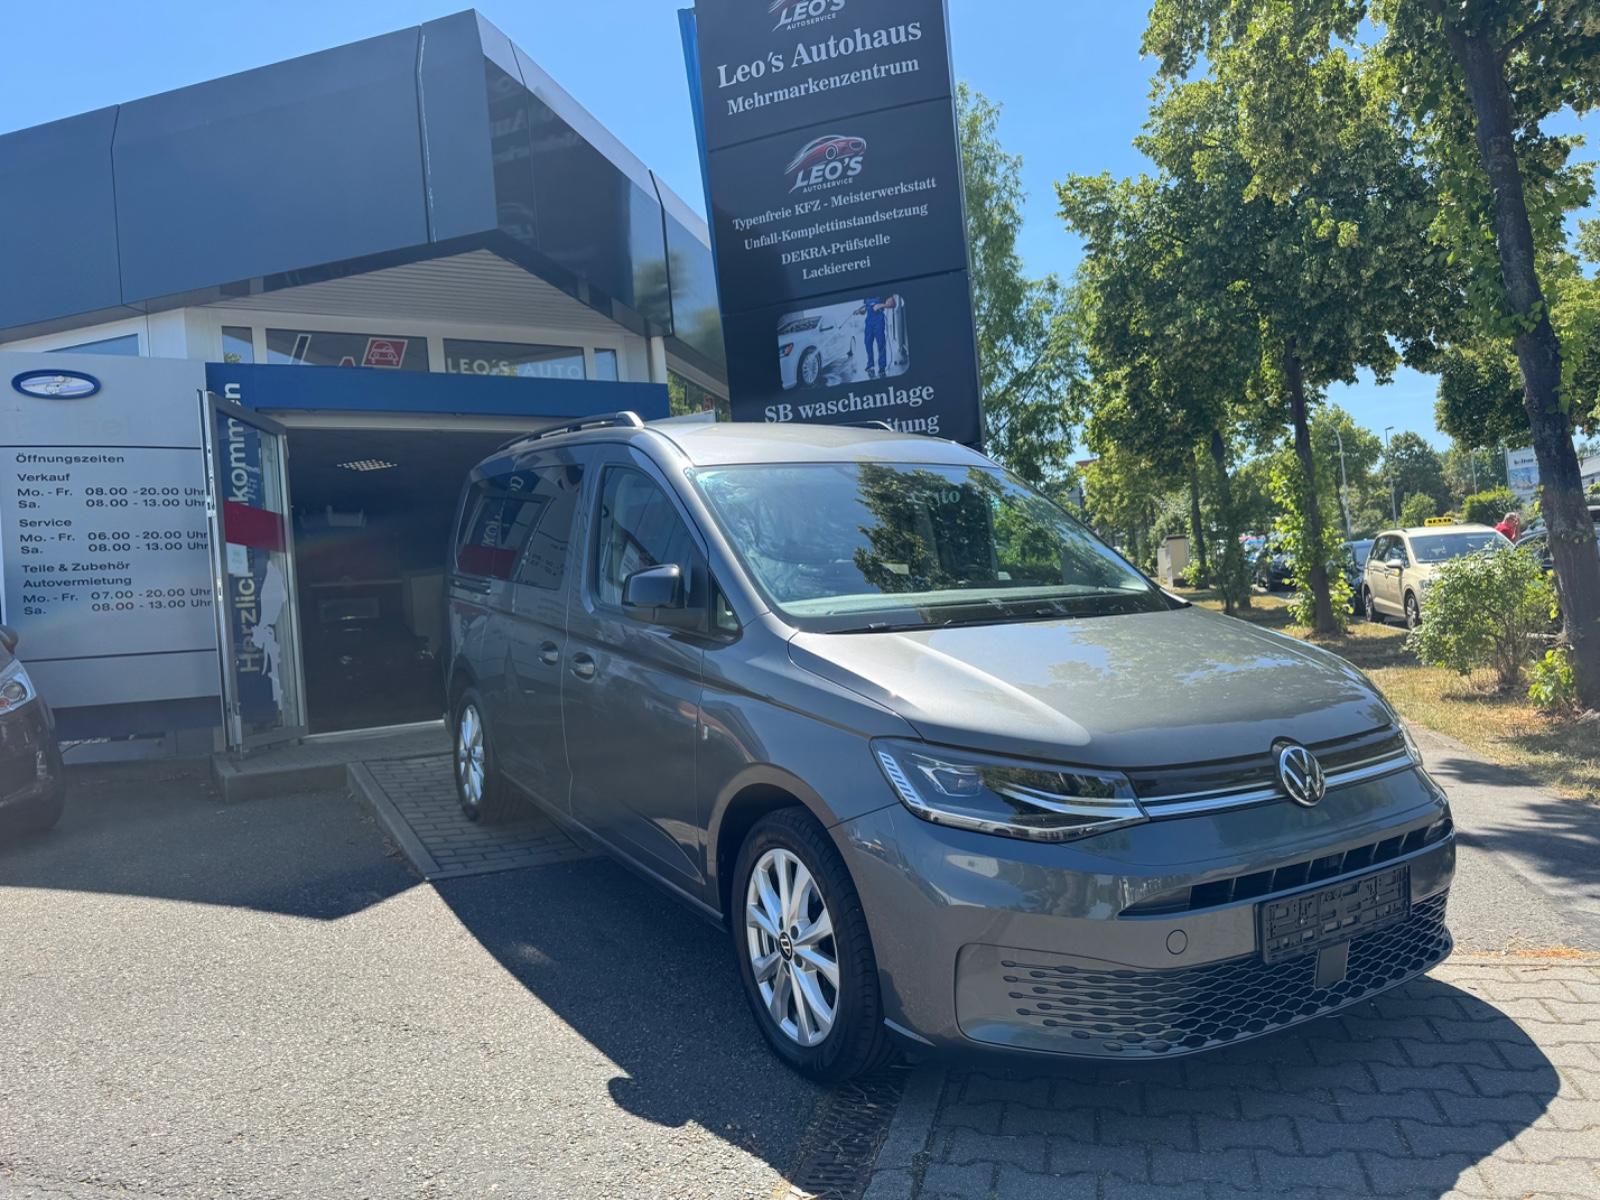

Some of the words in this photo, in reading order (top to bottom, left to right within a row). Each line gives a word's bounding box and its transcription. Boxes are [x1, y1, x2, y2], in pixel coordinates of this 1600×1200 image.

[791, 21, 922, 69] Autohaus
[727, 58, 920, 116] Mehrmarkenzentrum
[803, 178, 853, 193] AUTOSERVICE
[732, 208, 792, 231] Typenfreie
[794, 199, 821, 217] KFZ
[830, 177, 937, 207] Meisterwerkstatt
[744, 203, 929, 251] Unfall-Komplettinstandsetzung
[781, 232, 891, 265] DEKRA-Prüfstelle
[802, 256, 871, 280] Lackiererei
[764, 403, 793, 423] SB
[798, 386, 934, 419] waschanlage
[886, 415, 940, 434] itung
[15, 453, 125, 465] Öffnungszeiten
[17, 473, 71, 482] Verkauf
[17, 489, 44, 497] Mo.
[56, 488, 73, 496] Fr.
[85, 487, 128, 496] 08.00
[140, 487, 179, 496] 20.00
[184, 487, 205, 496] Uhr
[18, 500, 40, 509] Sa.
[86, 499, 129, 508] 08.00
[144, 499, 180, 508] 13.00
[185, 499, 206, 507] Uhr
[19, 518, 72, 528] Service
[20, 534, 46, 543] Mo.
[58, 533, 75, 542] Fr.
[143, 531, 182, 540] 20.00
[187, 531, 208, 539] Uhr
[21, 546, 43, 555] Sa.
[88, 543, 131, 552] 08.00
[146, 542, 183, 551] 13.00
[188, 542, 209, 550] Uhr
[22, 565, 55, 573] Teile
[59, 564, 67, 572] &
[72, 562, 130, 572] Zubehör
[23, 577, 132, 589] Autovermietung
[23, 595, 50, 604] Mo.
[62, 593, 79, 602] Fr.
[91, 591, 134, 601] 07.00
[146, 588, 185, 598] 20.00
[190, 588, 211, 597] Uhr
[24, 607, 47, 616] Sa.
[92, 603, 134, 612] 08.00
[150, 600, 186, 610] 13.00
[191, 600, 212, 608] Uhr
